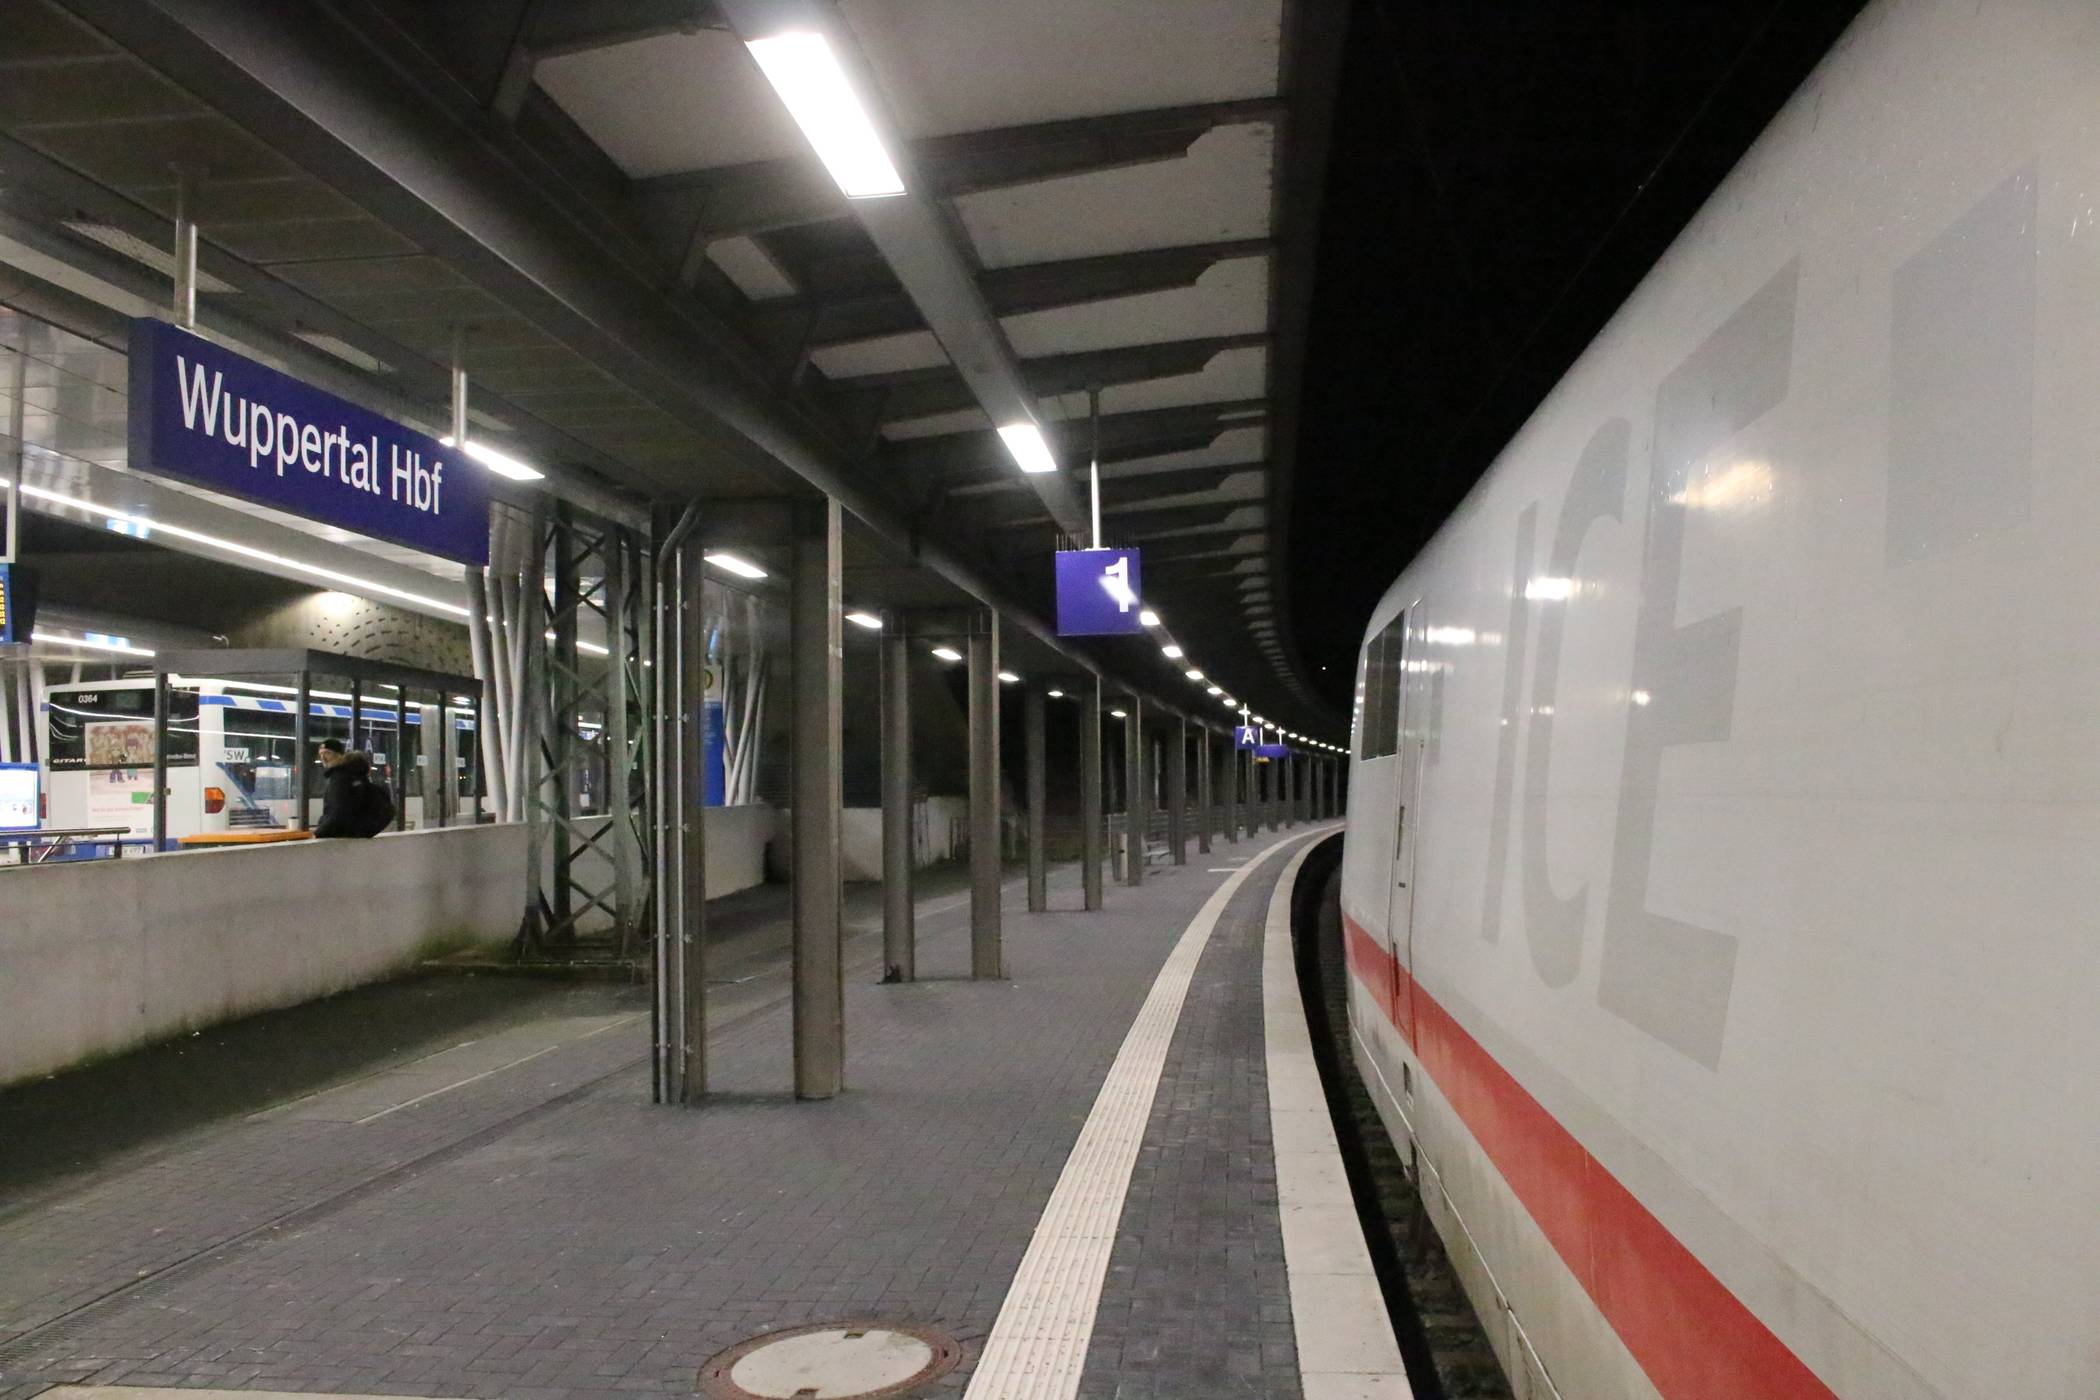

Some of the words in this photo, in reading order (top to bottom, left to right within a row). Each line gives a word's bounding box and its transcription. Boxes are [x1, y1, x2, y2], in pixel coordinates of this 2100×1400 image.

[177, 355, 381, 496] Wuppertal
[391, 443, 443, 515] Hbf
[1105, 556, 1129, 613] 1
[1480, 254, 1800, 1073] ICE
[78, 694, 98, 704] 0364
[1241, 728, 1255, 744] A
